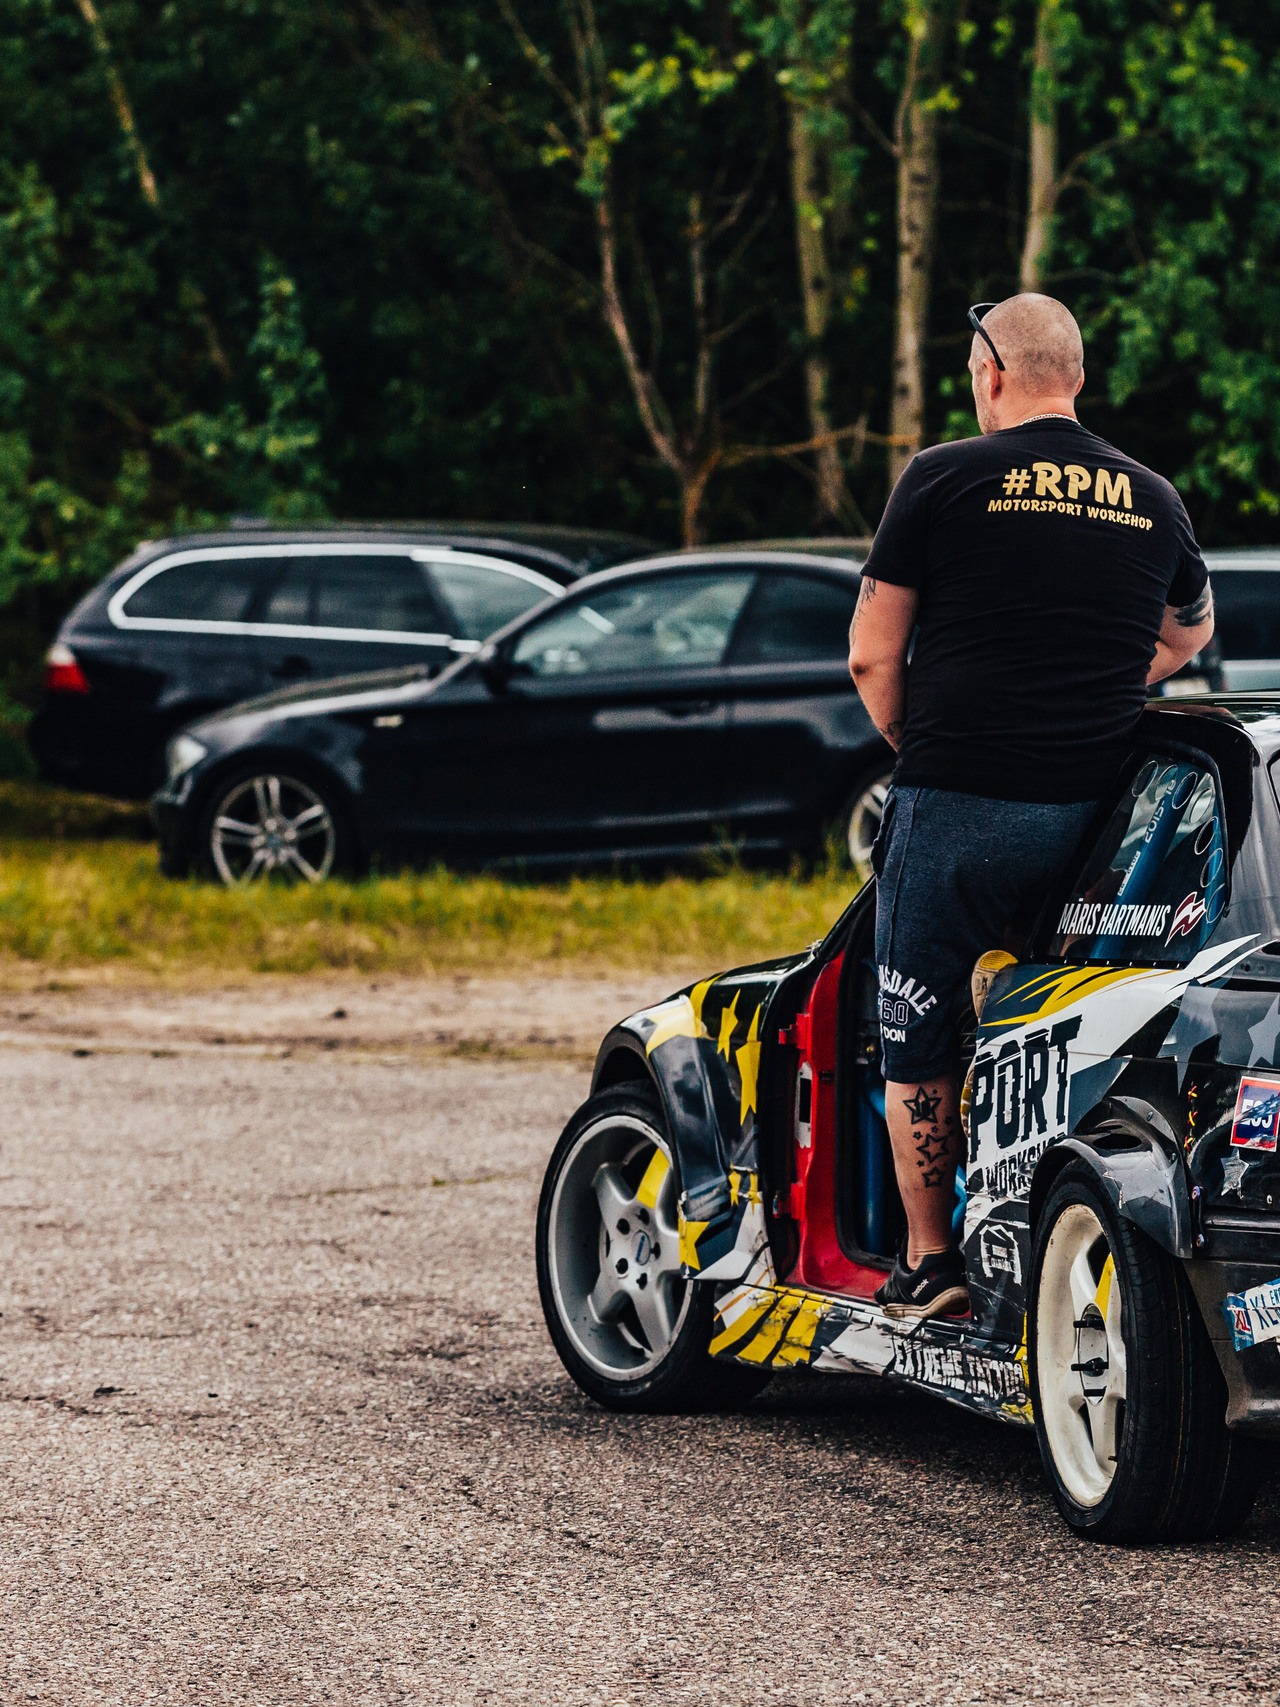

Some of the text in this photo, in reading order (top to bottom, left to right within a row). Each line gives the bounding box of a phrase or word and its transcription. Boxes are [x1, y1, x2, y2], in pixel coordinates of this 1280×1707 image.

[1002, 462, 1133, 509] #RPM
[988, 499, 1153, 531] MOTORSPORT WORKSHOP
[1056, 897, 1172, 937] MĀRIS HARTMANIS
[878, 964, 938, 1017] NSDALE
[878, 995, 909, 1026] 60
[880, 1022, 906, 1043] DON
[1233, 1309, 1251, 1332] XL
[1249, 1294, 1279, 1330] XL
